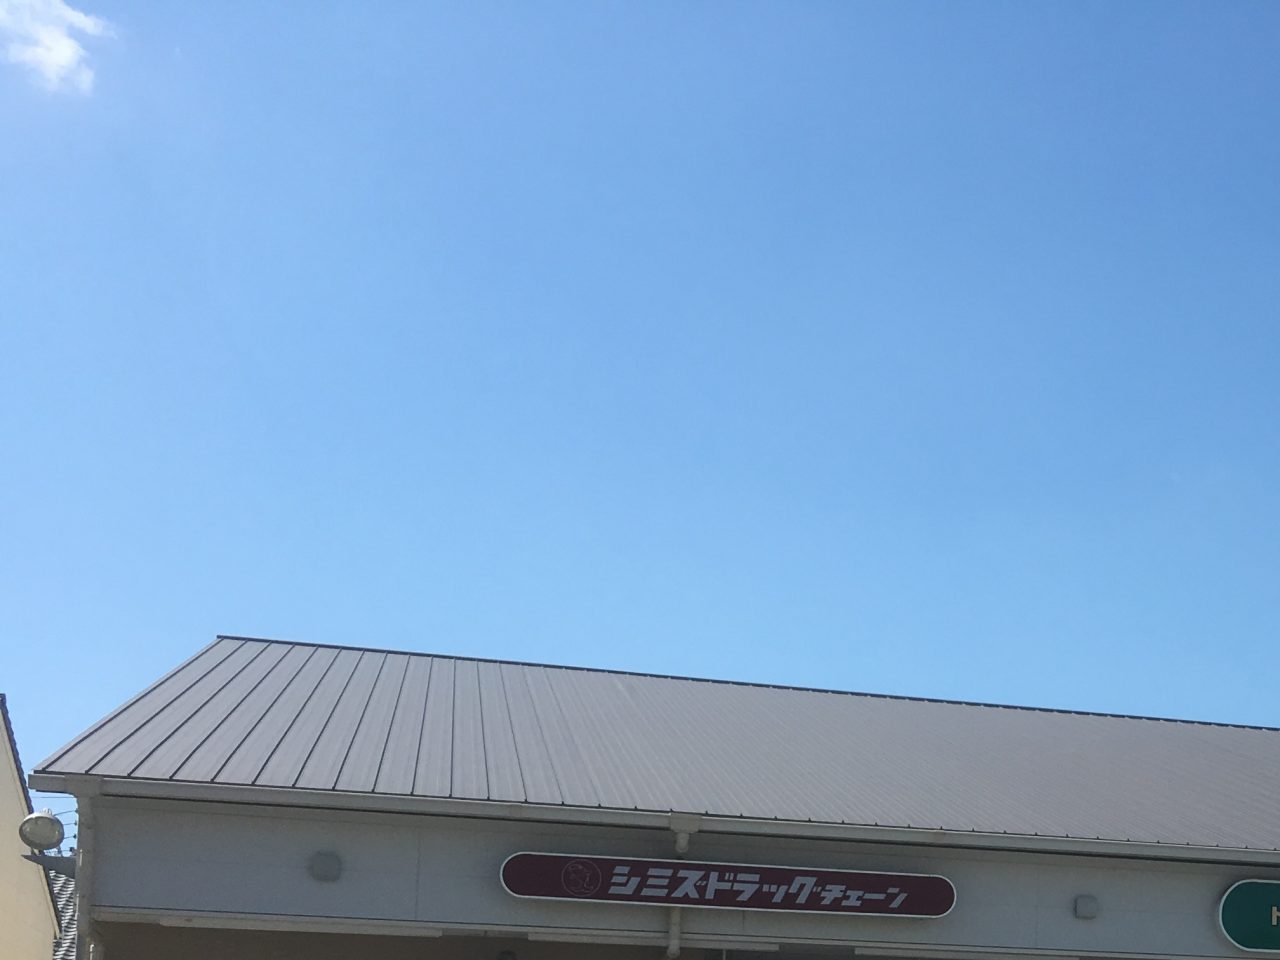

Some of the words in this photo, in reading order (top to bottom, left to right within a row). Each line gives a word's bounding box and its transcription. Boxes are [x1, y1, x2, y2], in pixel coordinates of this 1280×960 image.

[608, 866, 907, 908] シミズドラッグチェーン
